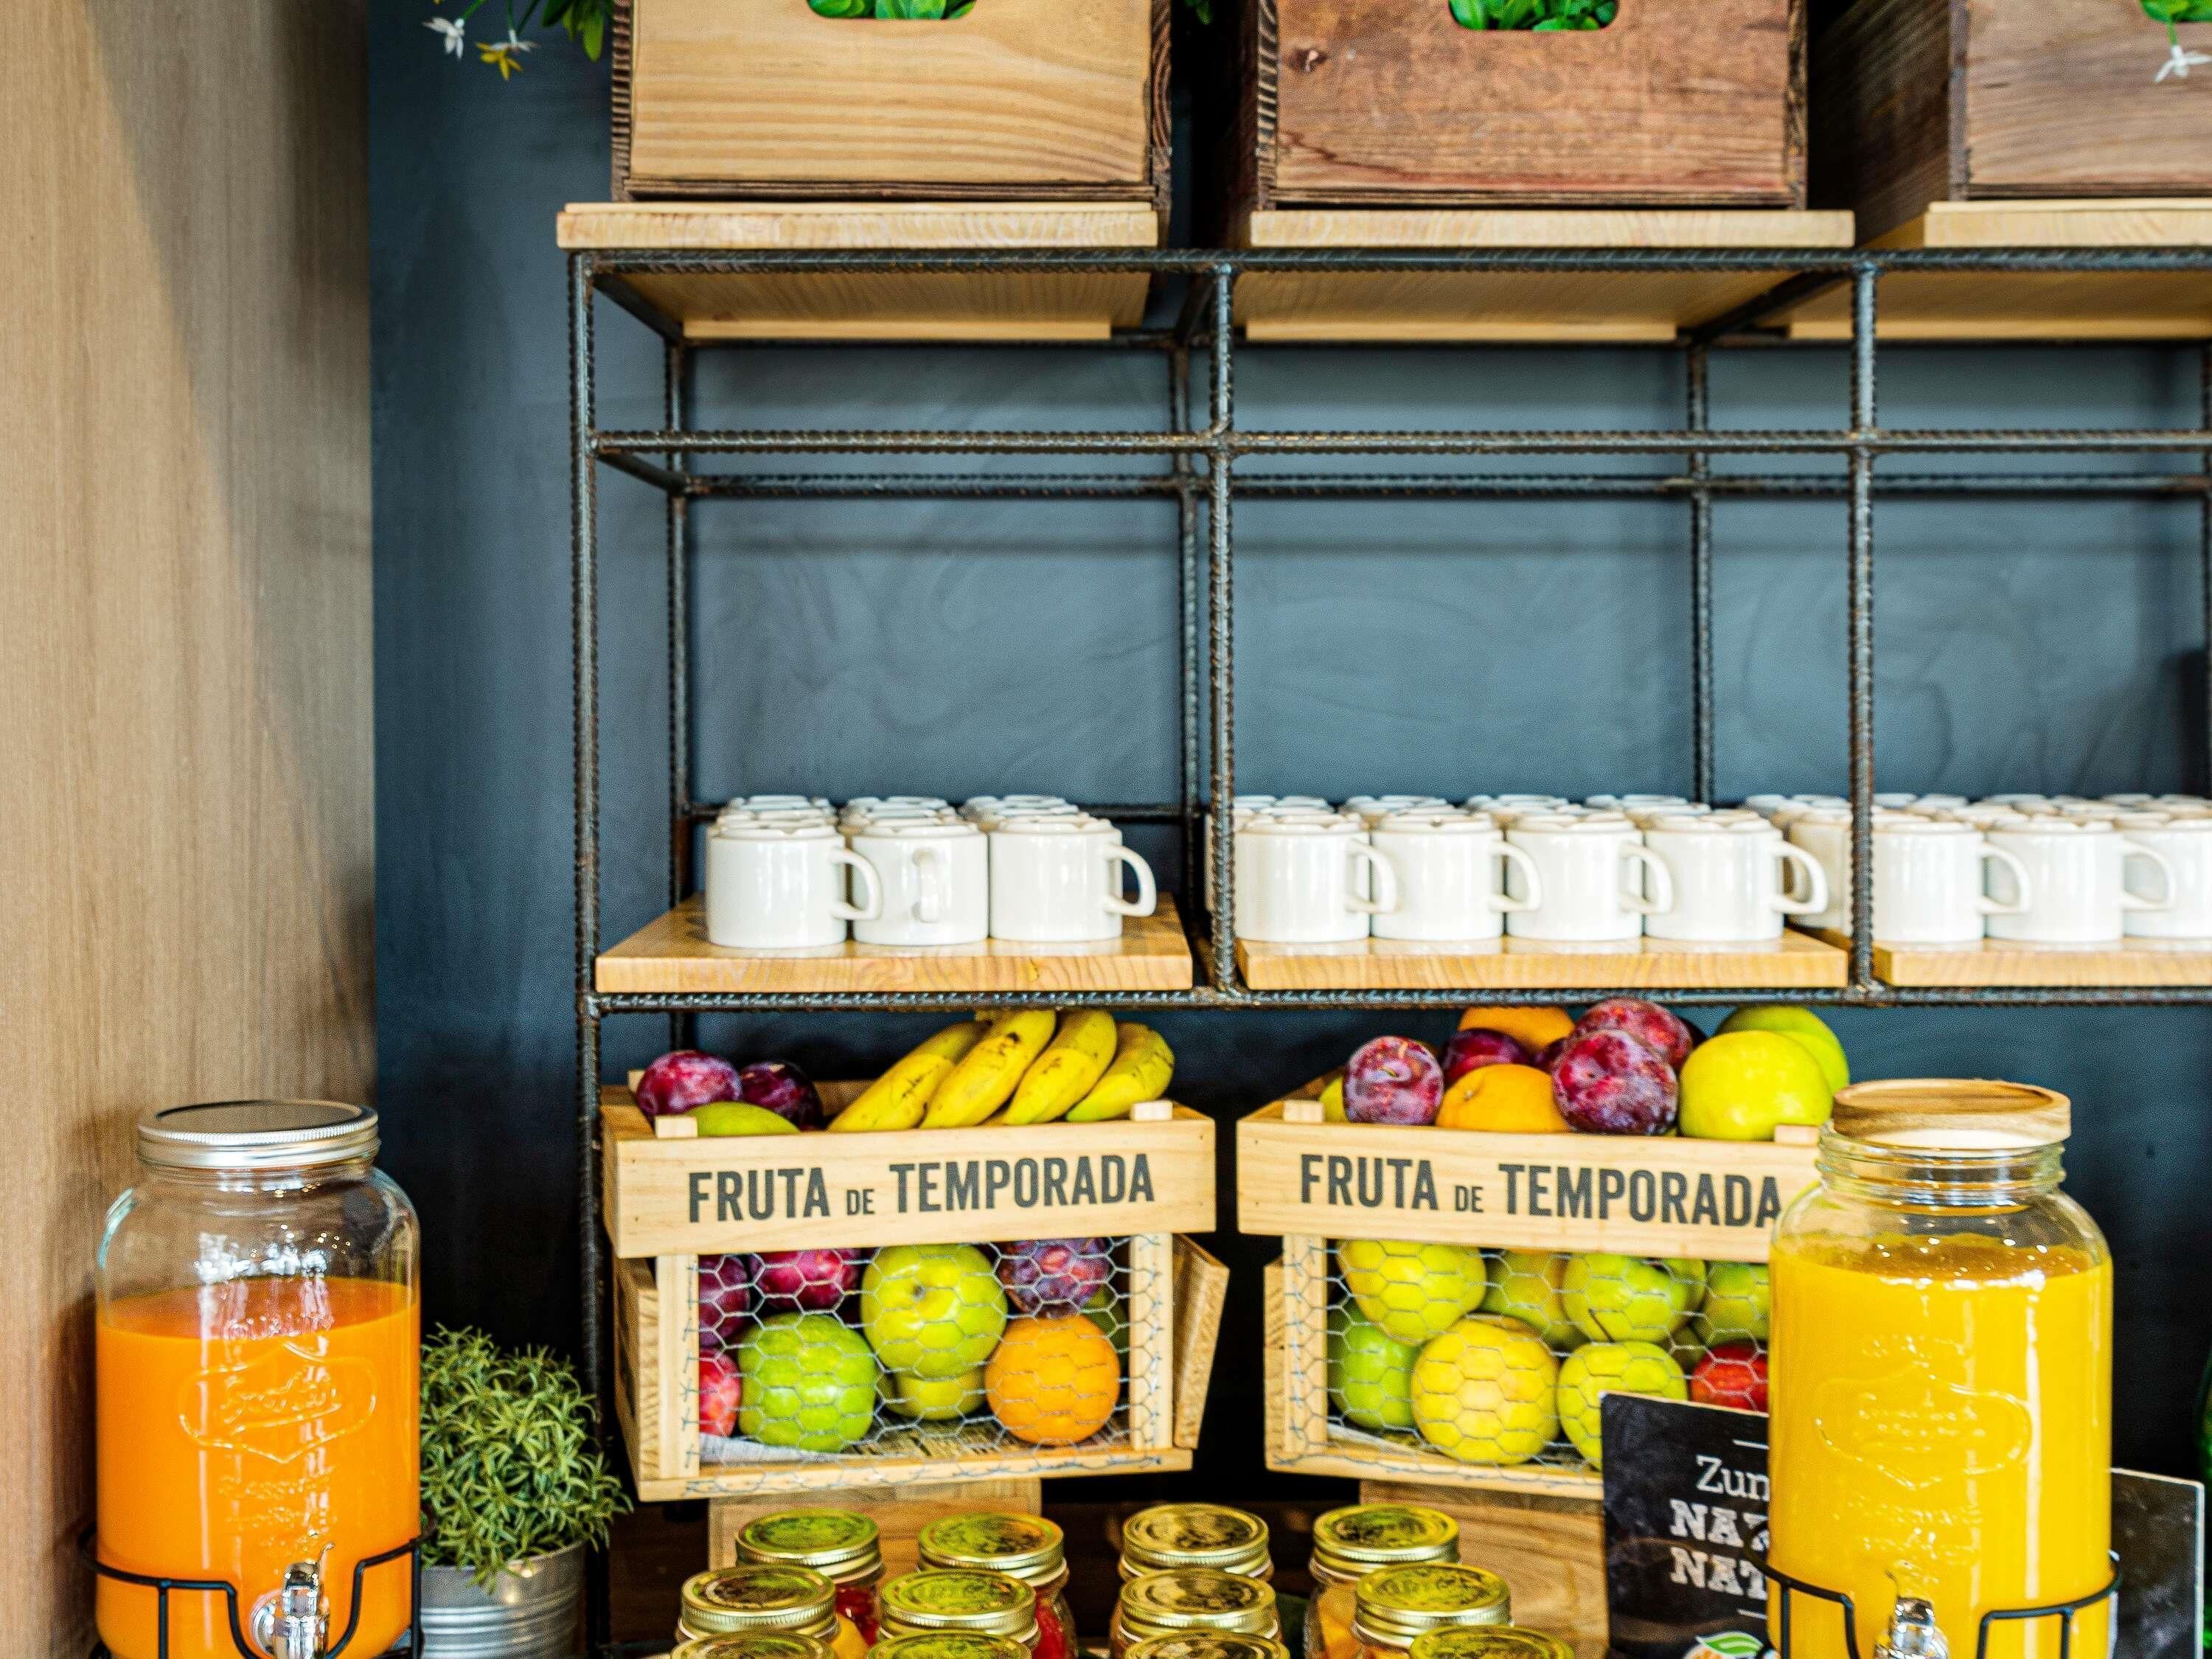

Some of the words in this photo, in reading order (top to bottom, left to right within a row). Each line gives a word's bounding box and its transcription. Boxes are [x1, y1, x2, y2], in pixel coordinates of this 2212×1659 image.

[688, 1166, 830, 1223] FRUTA
[846, 1189, 875, 1217] DE
[889, 1153, 1155, 1214] TEMPORADA
[1300, 1154, 1439, 1211] FRUTA
[1454, 1185, 1484, 1214] DE
[1498, 1164, 1781, 1228] TEMPORADA
